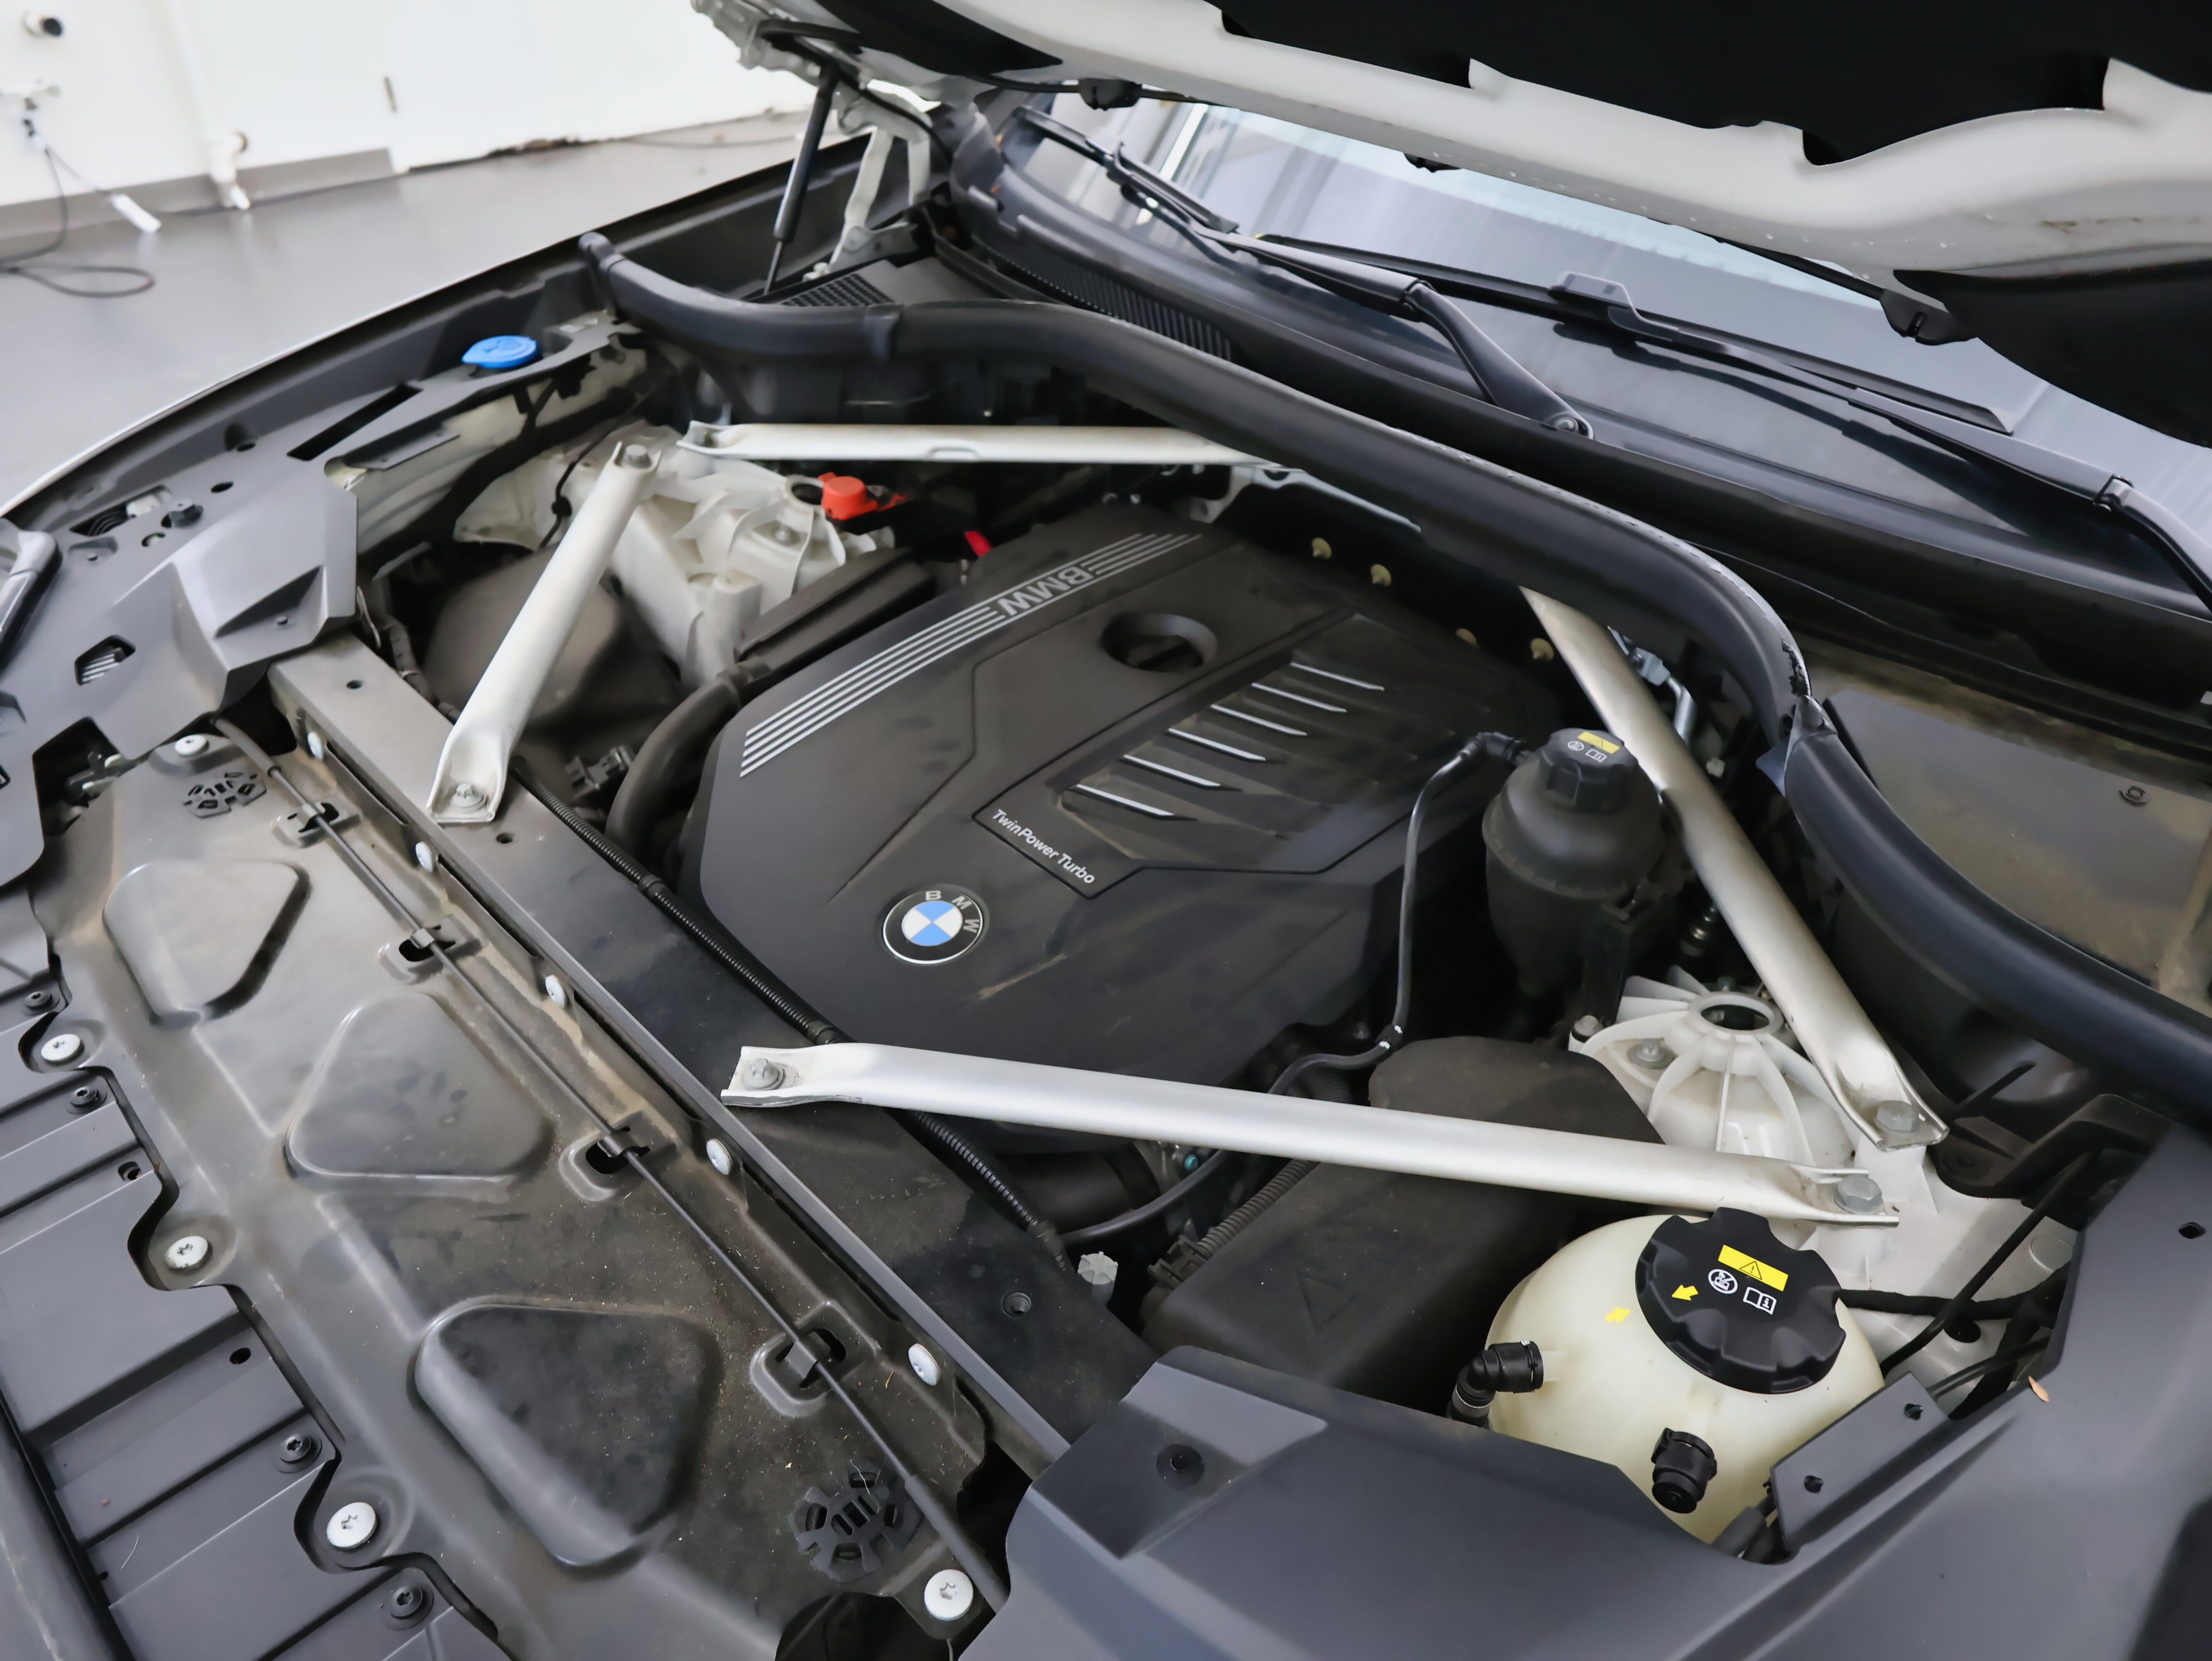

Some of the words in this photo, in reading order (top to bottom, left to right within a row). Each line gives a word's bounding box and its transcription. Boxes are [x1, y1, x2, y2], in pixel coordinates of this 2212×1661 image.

[998, 566, 1094, 615] BMW
[993, 809, 1060, 858] TwinPower
[1057, 853, 1095, 883] Turbo
[926, 890, 980, 933] BMW
